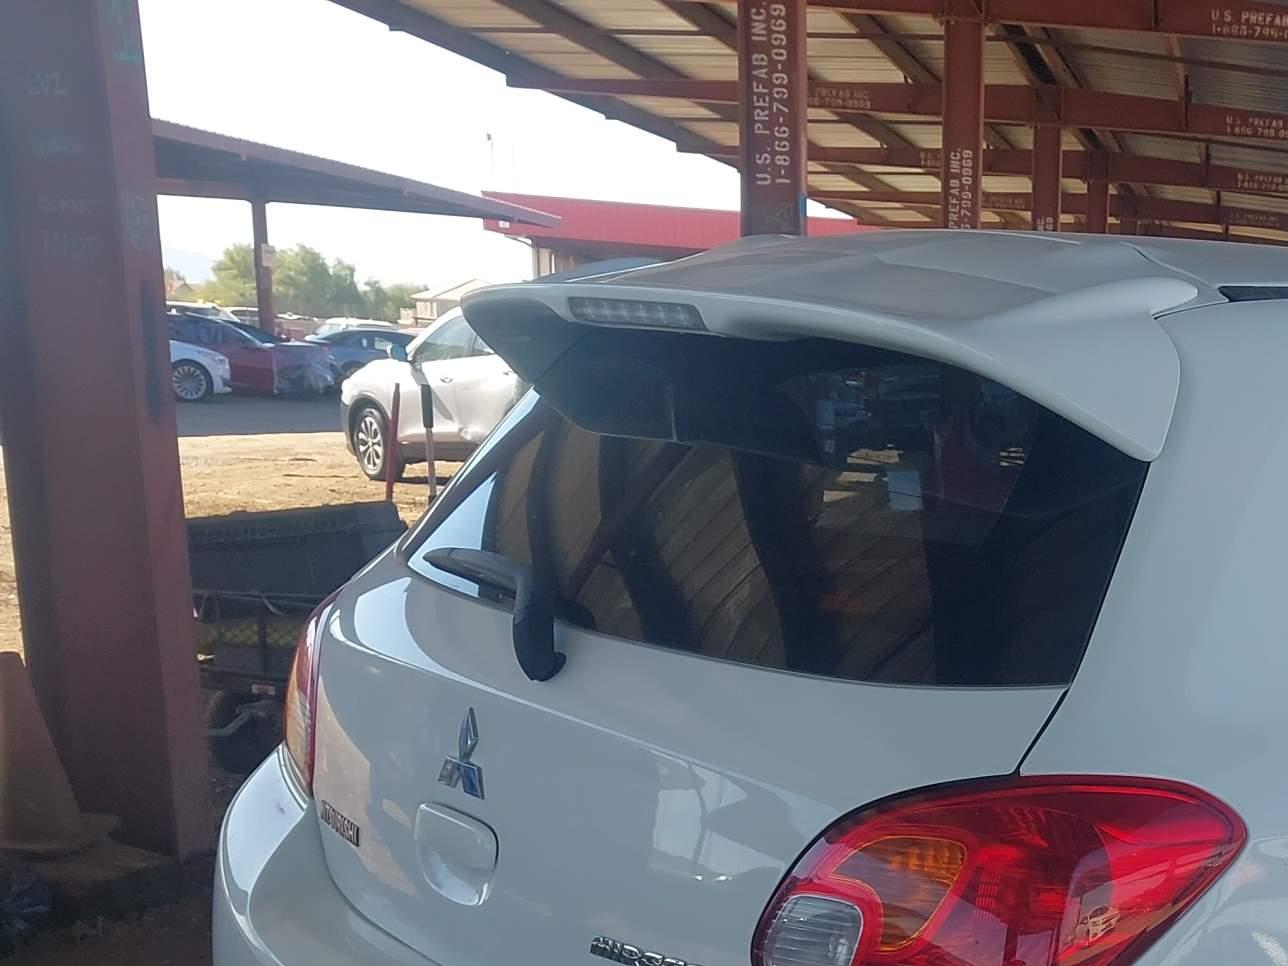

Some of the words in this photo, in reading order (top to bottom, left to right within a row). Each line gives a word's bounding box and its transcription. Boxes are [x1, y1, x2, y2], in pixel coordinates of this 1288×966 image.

[750, 0, 768, 42] INC.
[752, 53, 770, 135] PREFAB
[769, 3, 791, 185] 1-866-799-0969
[755, 146, 772, 186] U.S.
[948, 178, 960, 229] PREFAB
